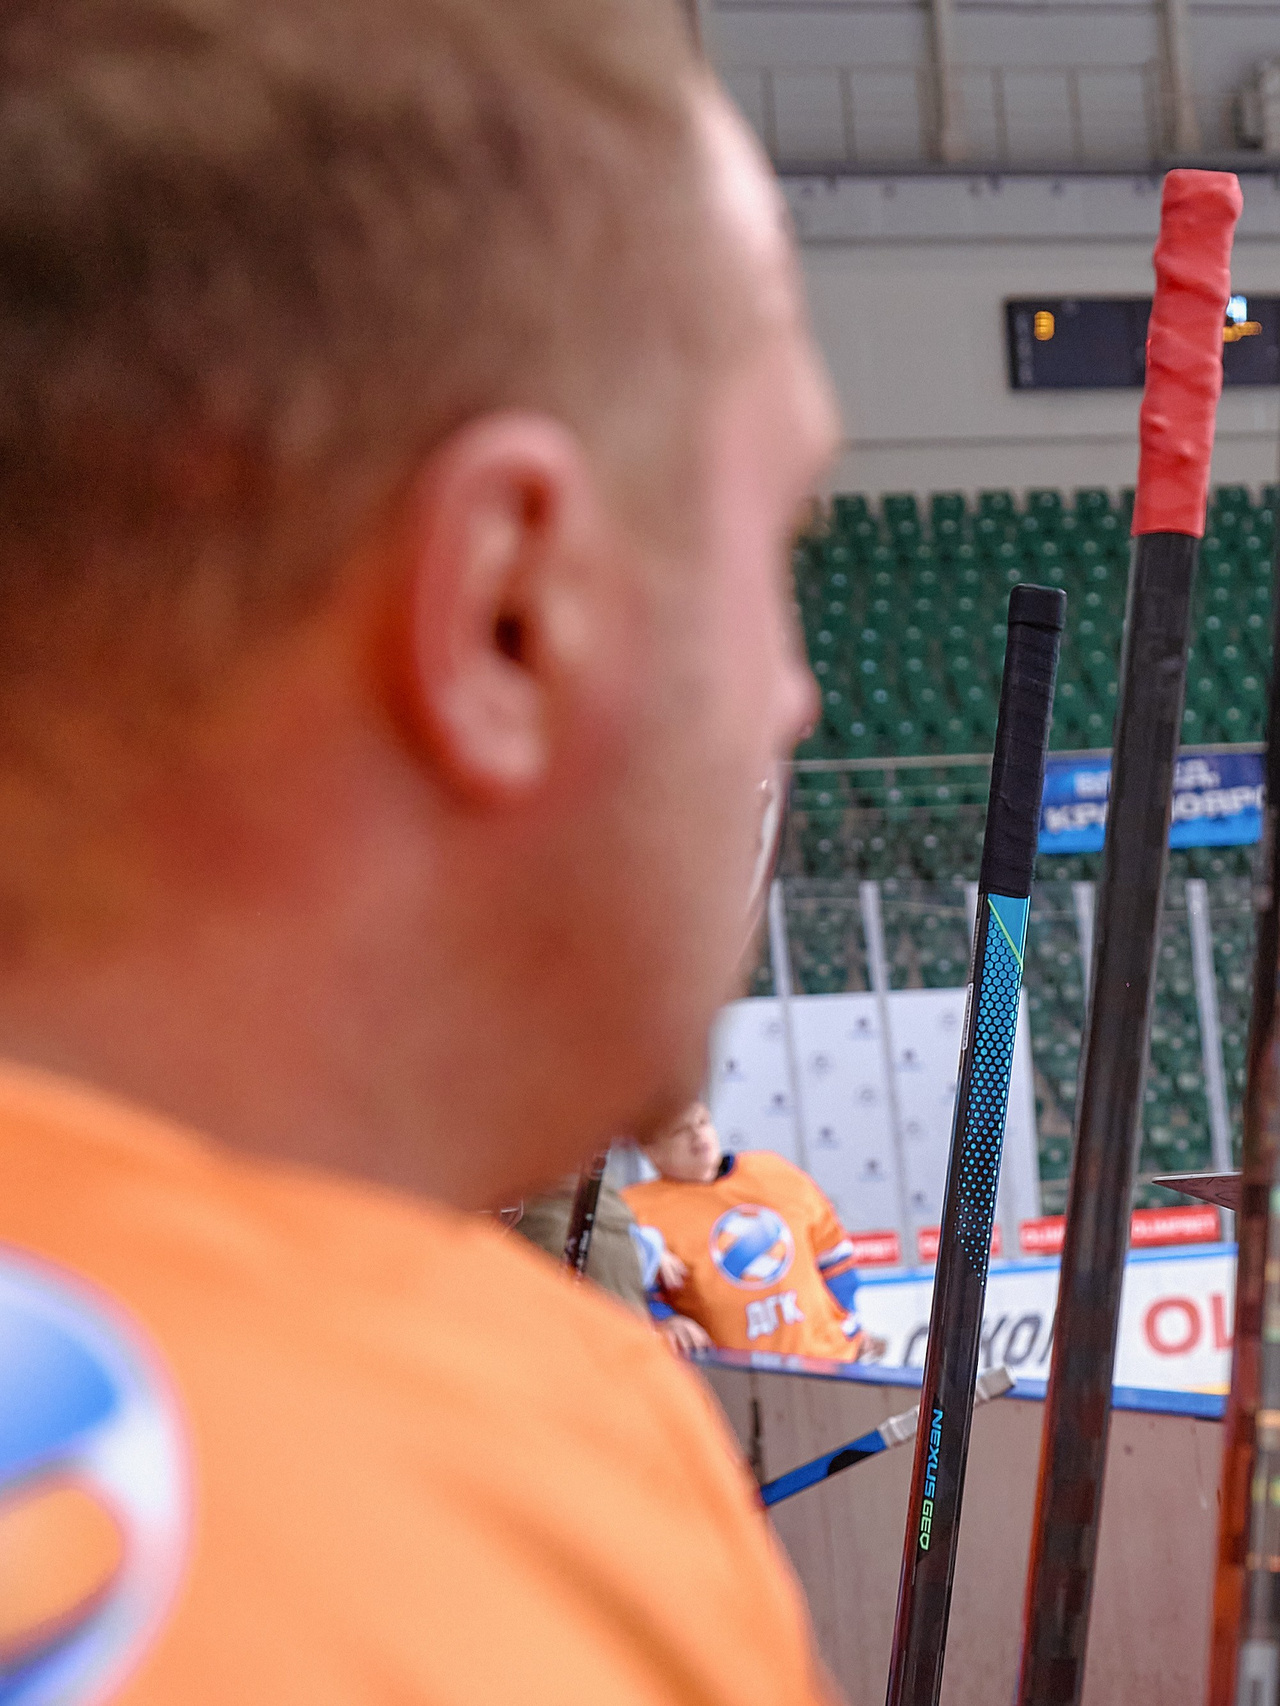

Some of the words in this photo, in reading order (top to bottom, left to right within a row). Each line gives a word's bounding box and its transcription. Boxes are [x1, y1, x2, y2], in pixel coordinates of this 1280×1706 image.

[745, 1289, 804, 1339] ДГК
[925, 1408, 944, 1499] NEXUS
[919, 1499, 934, 1550] GEO
